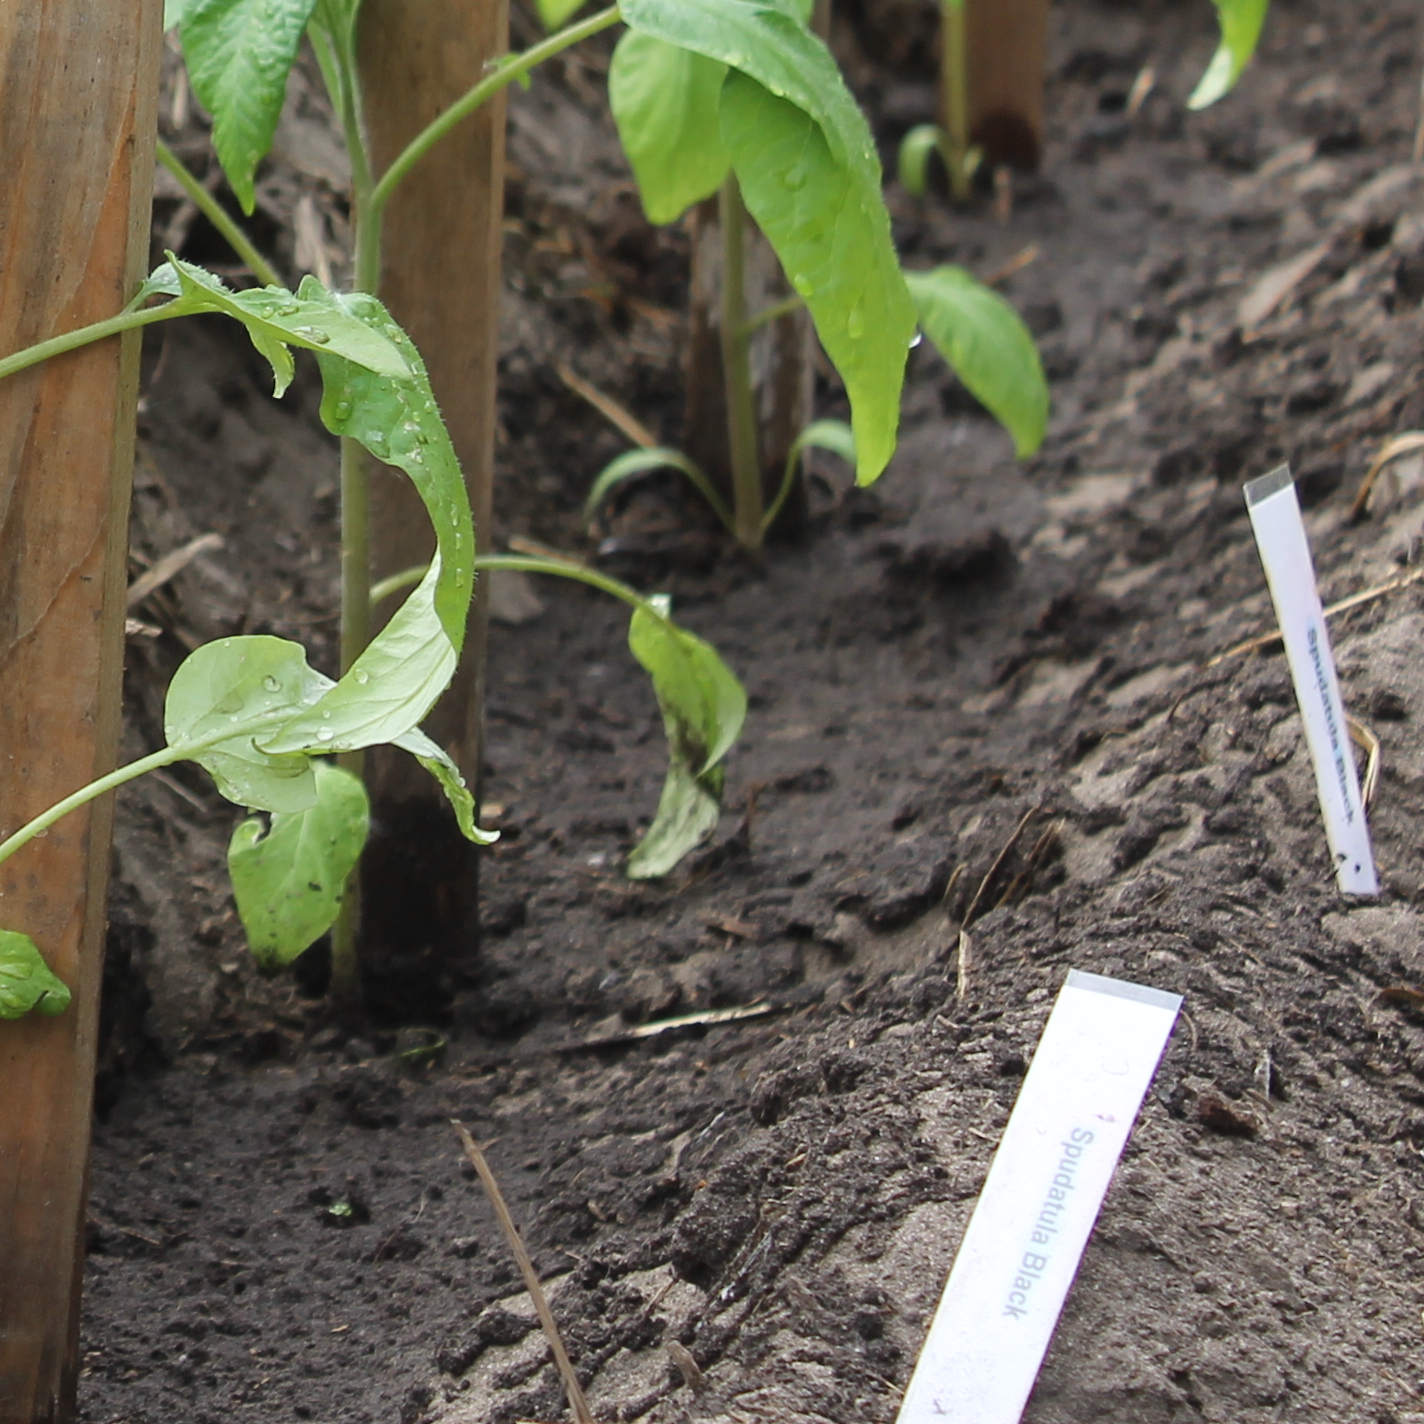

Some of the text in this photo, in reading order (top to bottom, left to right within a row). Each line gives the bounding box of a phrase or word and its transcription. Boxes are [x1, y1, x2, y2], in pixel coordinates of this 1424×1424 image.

[1334, 755, 1354, 824] Black
[1002, 1127, 1095, 1321] Spudatula Black
